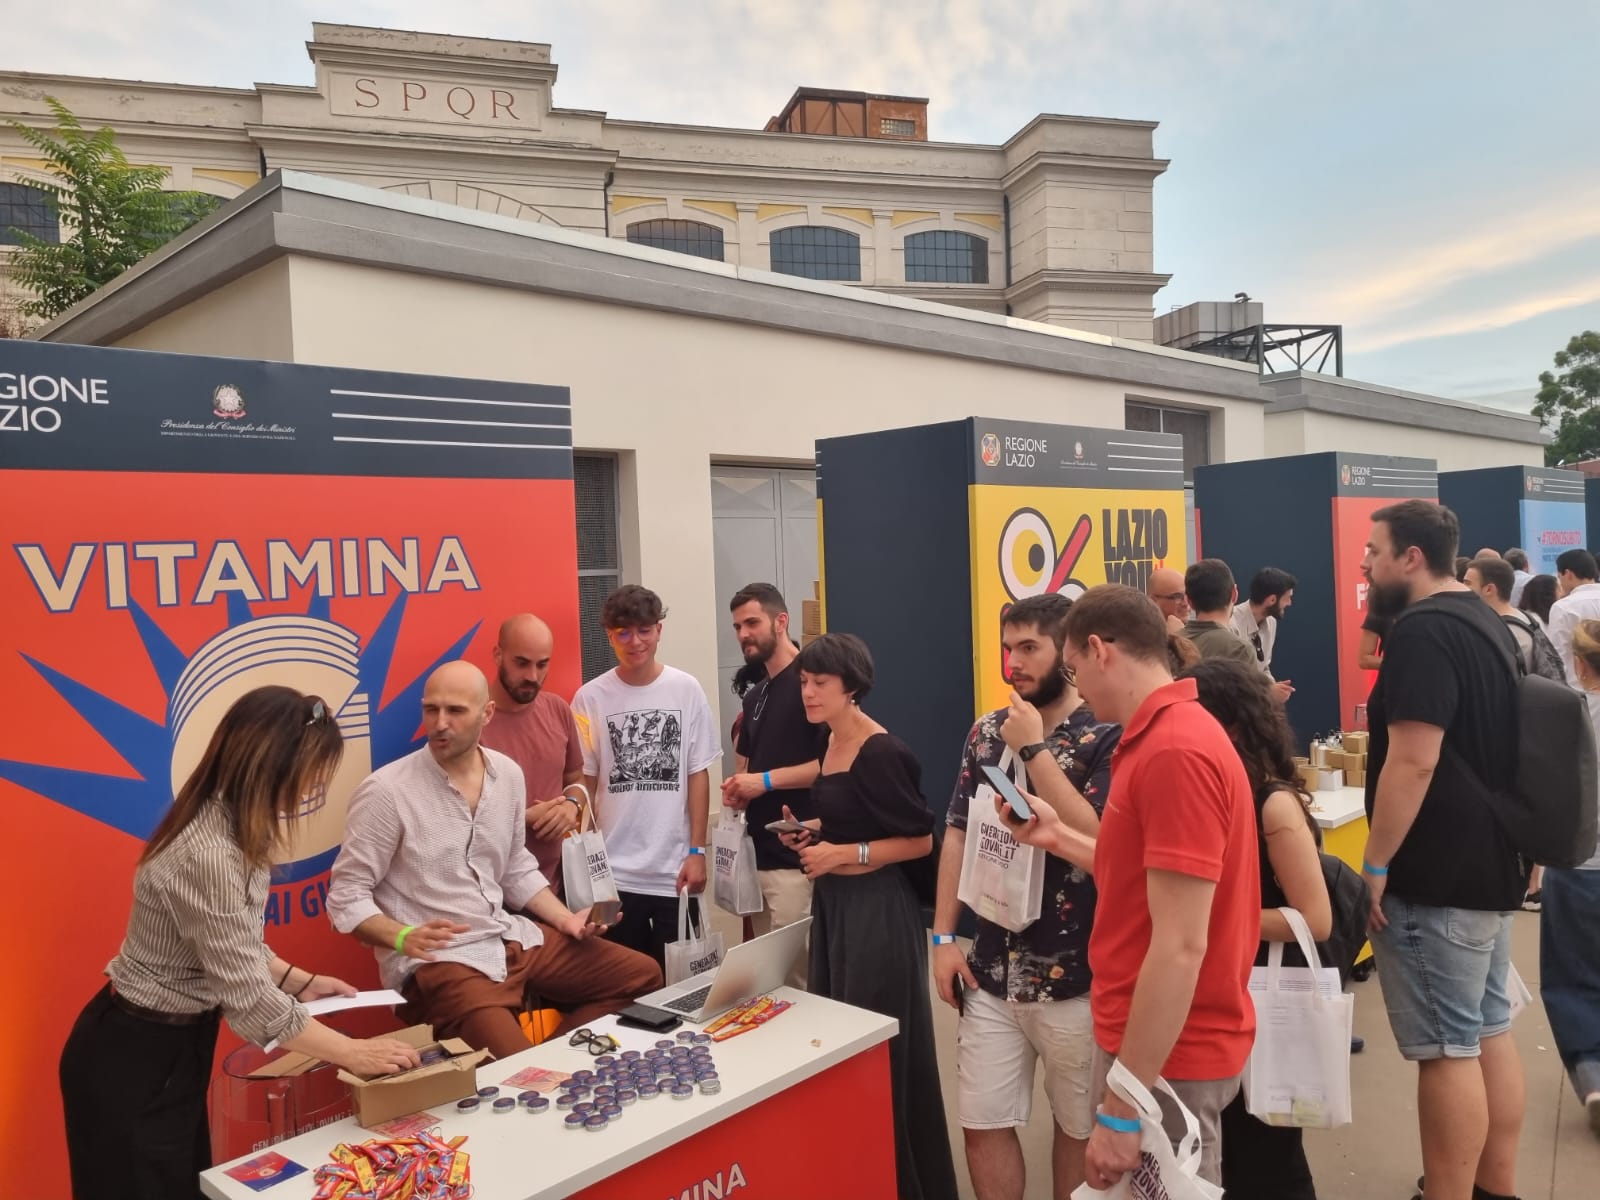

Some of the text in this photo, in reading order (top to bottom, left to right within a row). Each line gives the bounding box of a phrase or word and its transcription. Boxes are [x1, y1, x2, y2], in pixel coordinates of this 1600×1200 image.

[355, 78, 520, 120] SPQR
[1005, 437, 1047, 453] REGIONE
[1005, 453, 1036, 468] LAZIO
[1102, 508, 1168, 562] LAZIO
[12, 536, 482, 614] VITAMINA
[300, 877, 332, 918] GI
